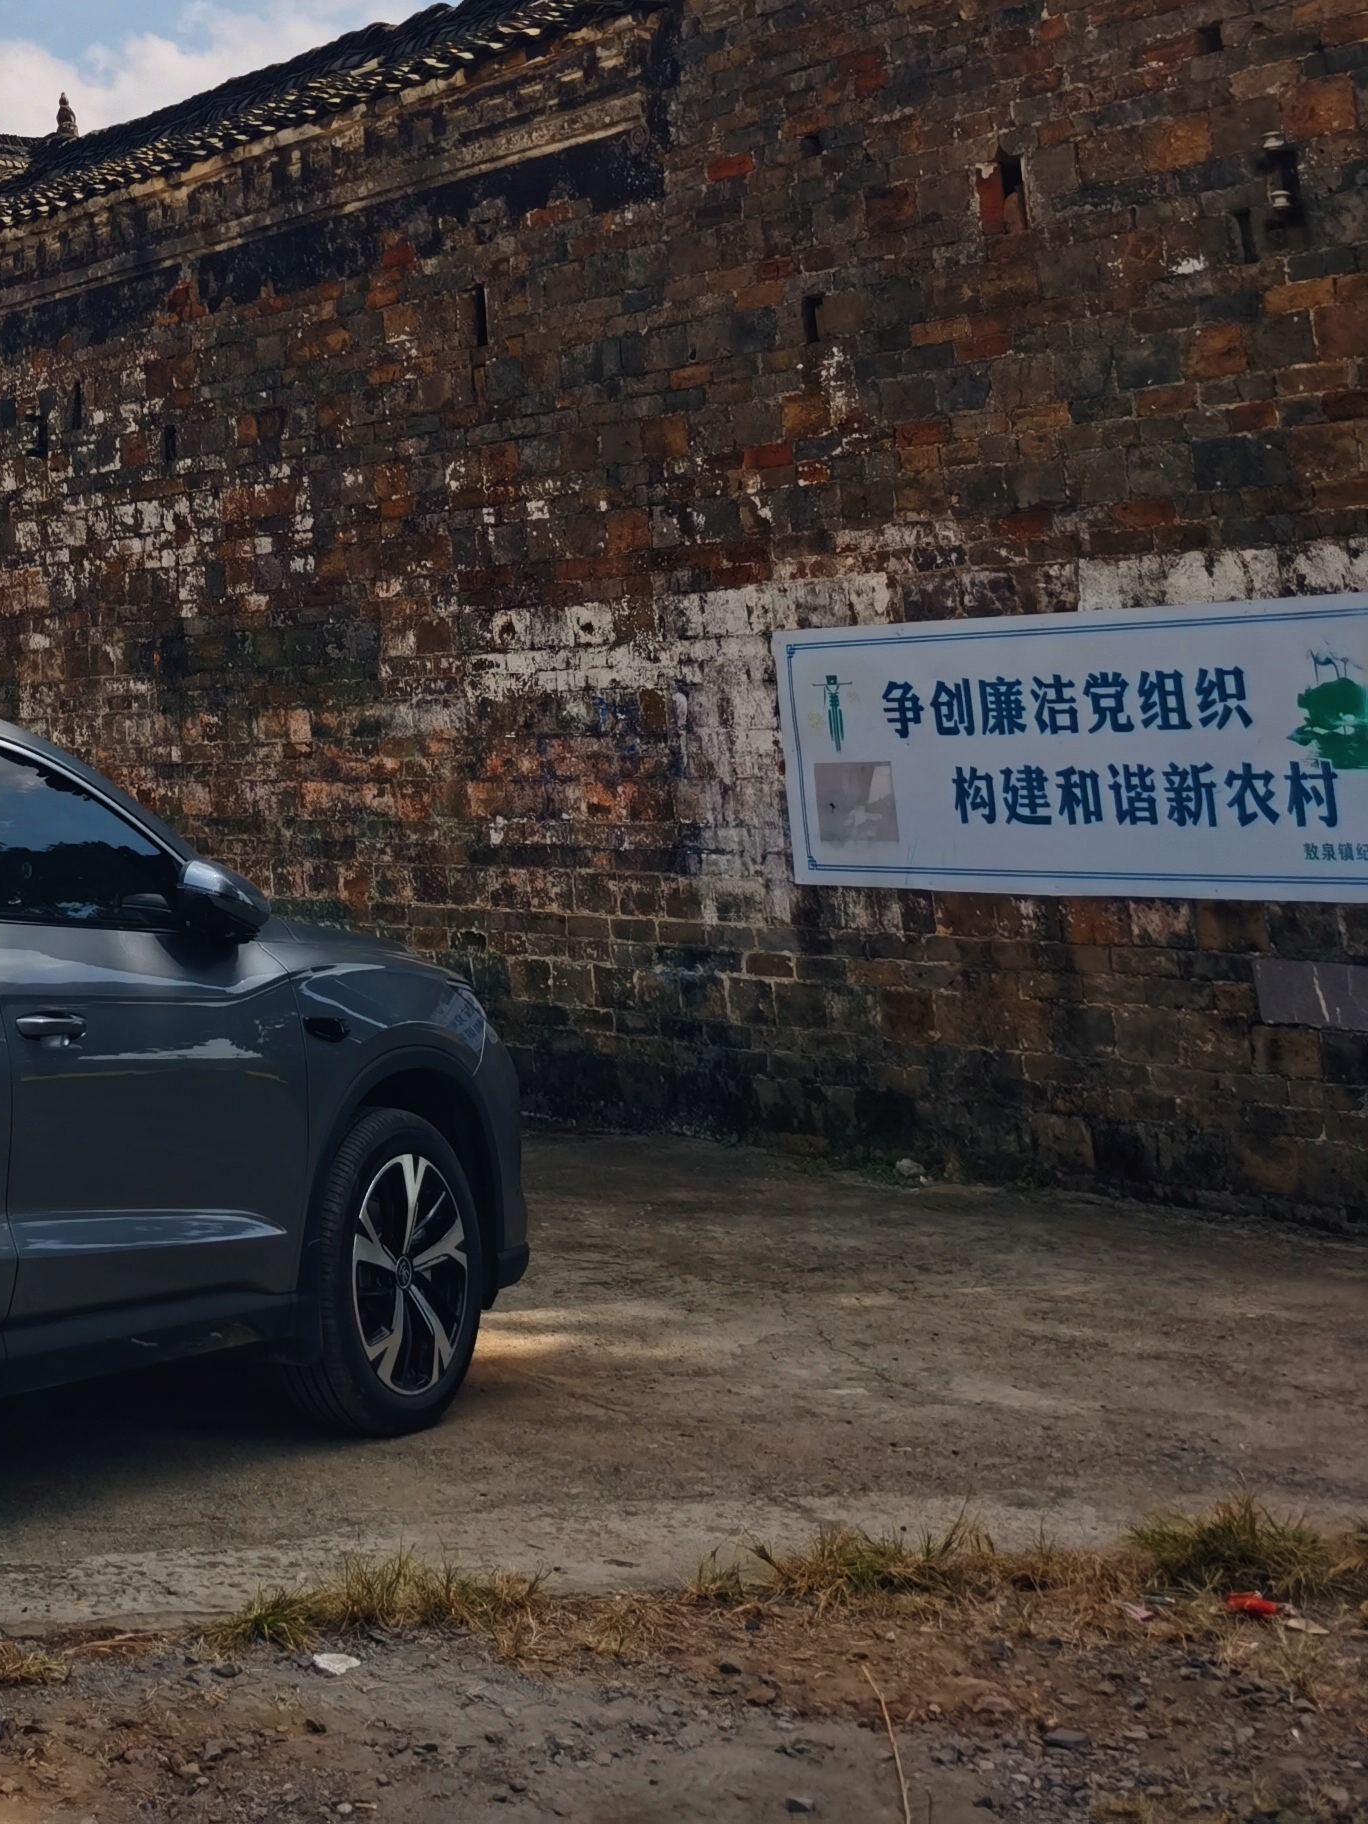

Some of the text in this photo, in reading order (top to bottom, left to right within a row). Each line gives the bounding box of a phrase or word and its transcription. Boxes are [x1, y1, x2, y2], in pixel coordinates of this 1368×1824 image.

[882, 666, 1253, 739] 争创廉洁党组织
[952, 761, 1339, 828] 构建和谐新农村
